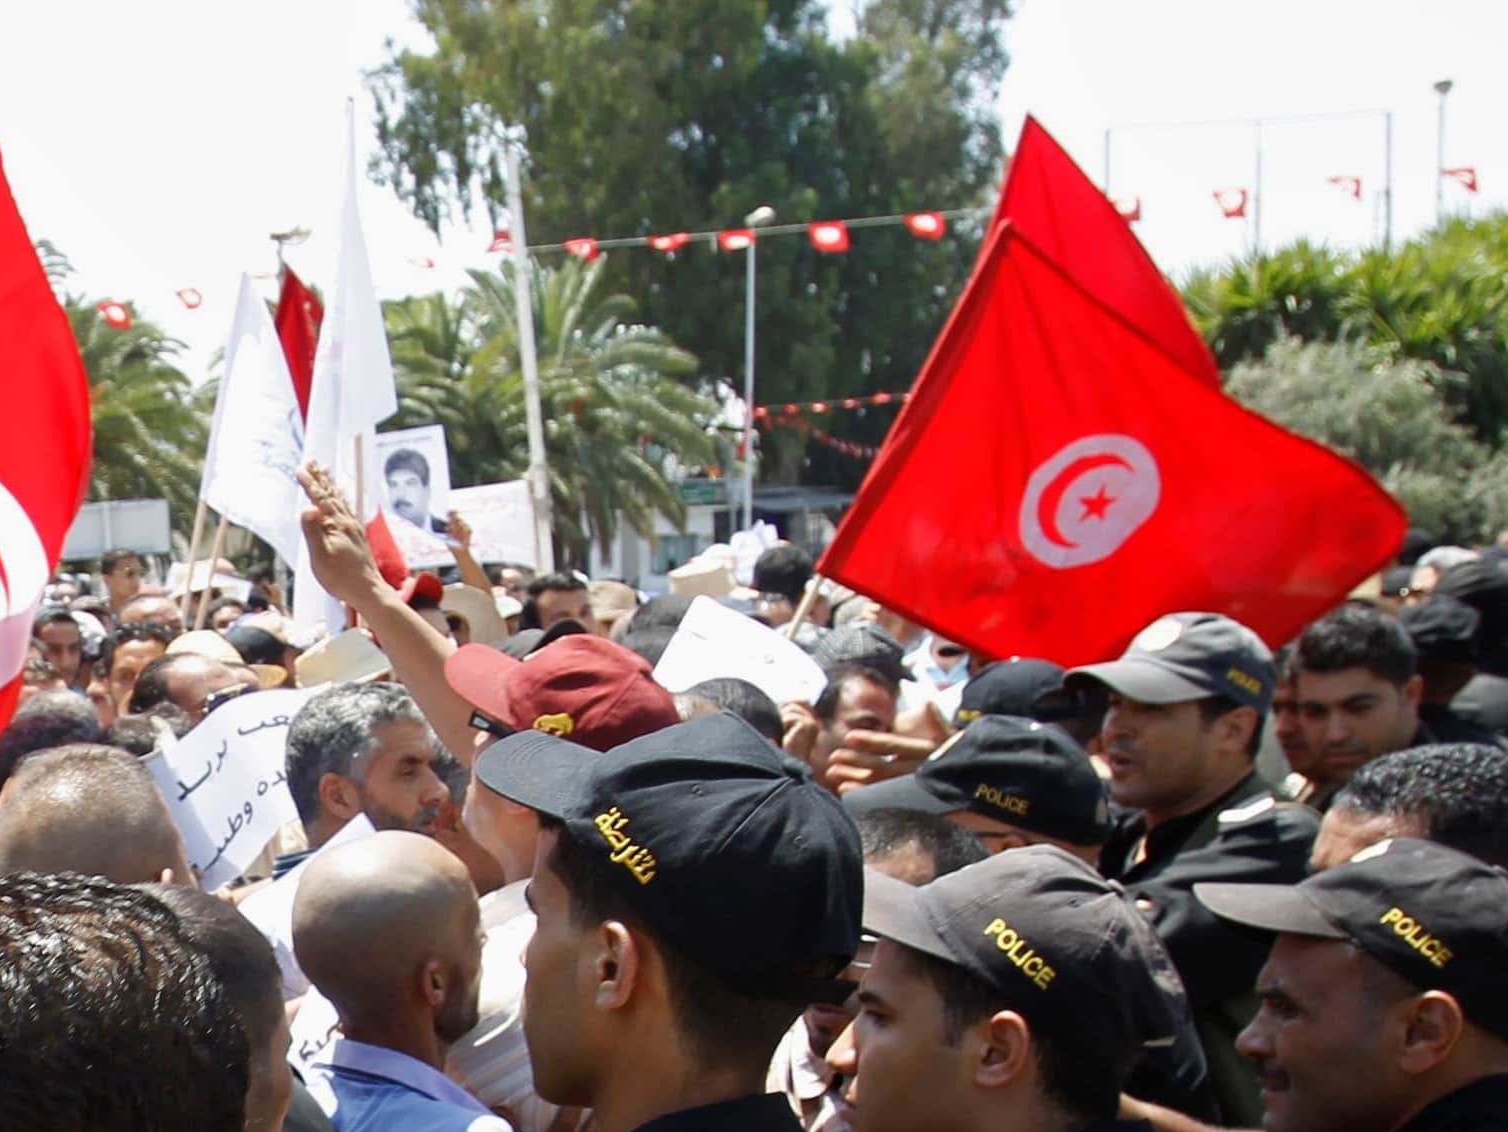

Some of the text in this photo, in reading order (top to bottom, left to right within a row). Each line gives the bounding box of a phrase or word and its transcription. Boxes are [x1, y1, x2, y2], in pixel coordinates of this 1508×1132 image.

[974, 783, 1029, 815] POLICE
[594, 806, 657, 886] شرطة
[983, 917, 1056, 991] POLICE
[1379, 907, 1453, 968] POLICE
